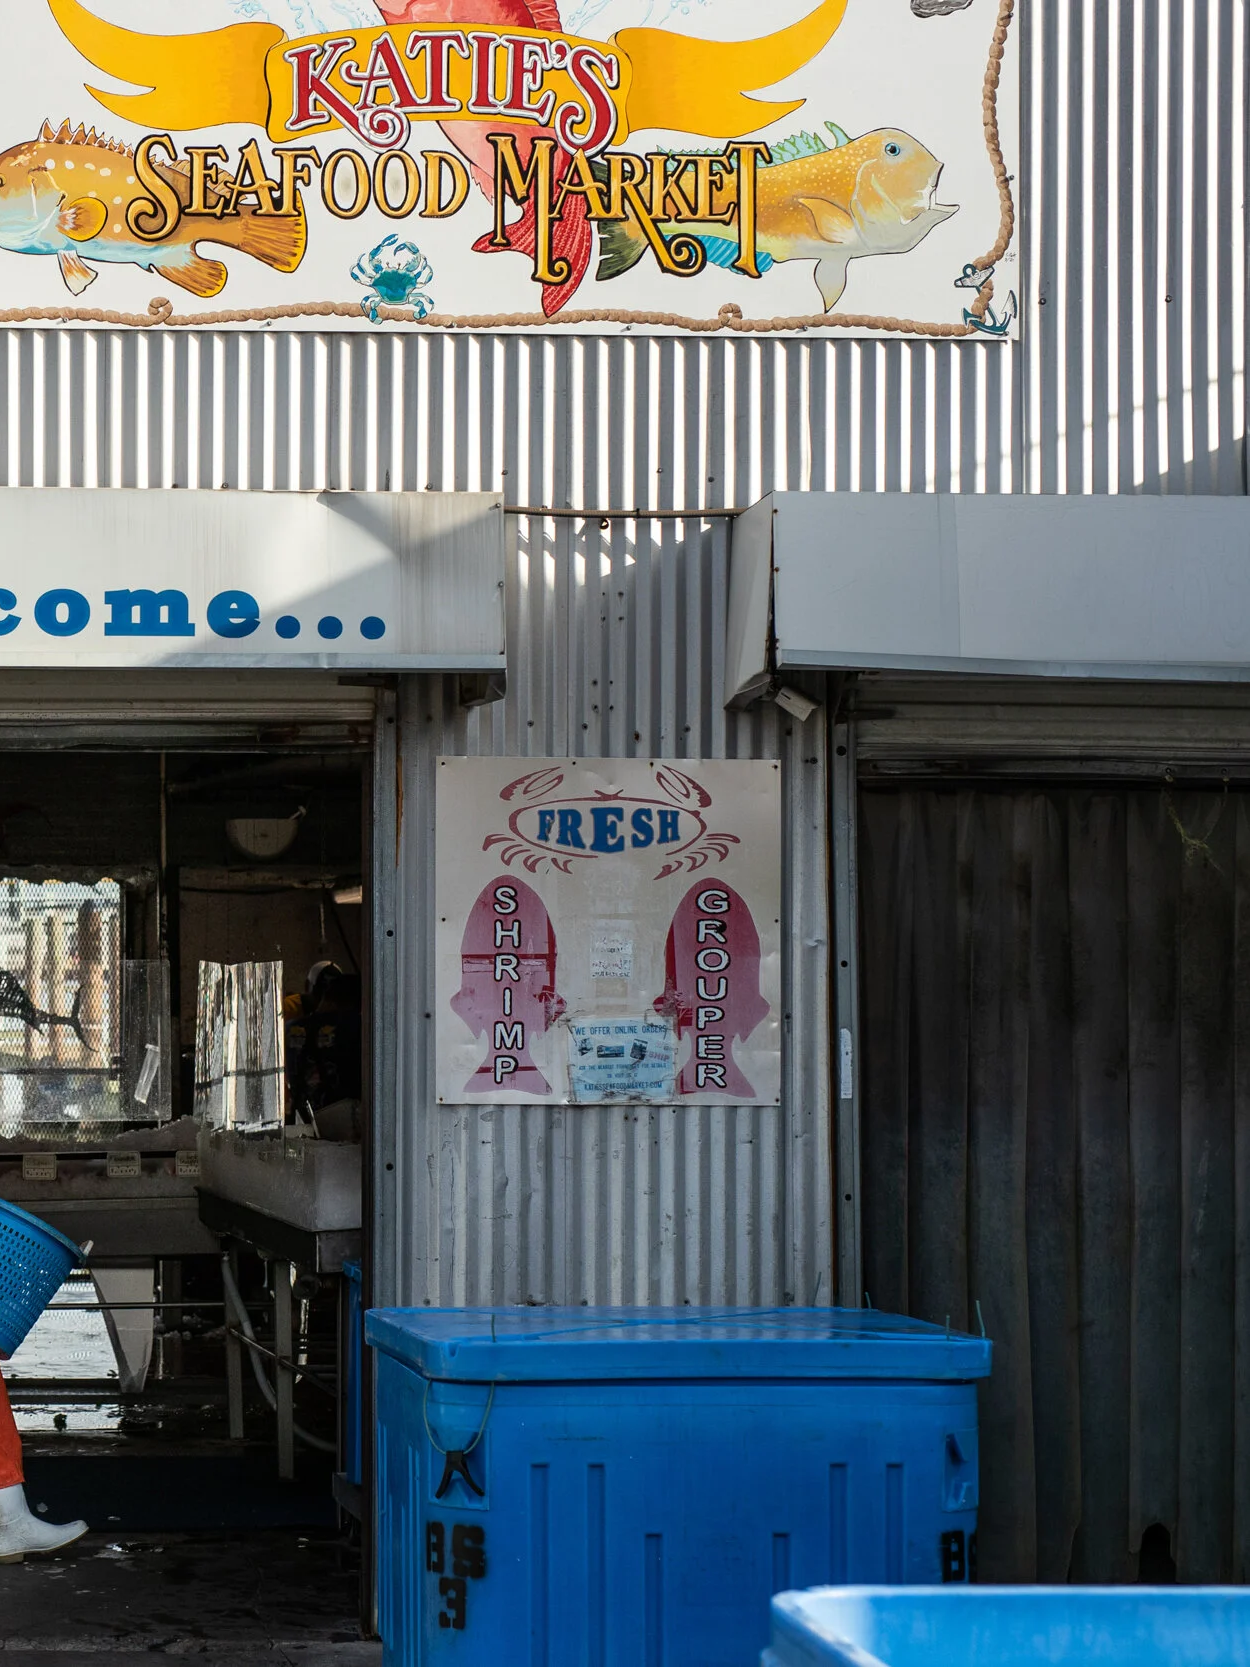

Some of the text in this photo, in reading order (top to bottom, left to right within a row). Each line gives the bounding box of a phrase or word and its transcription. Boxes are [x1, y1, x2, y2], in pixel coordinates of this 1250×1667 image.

[284, 29, 620, 154] KATIE'S
[126, 133, 777, 284] SEAFOOD MARKET
[537, 807, 680, 853] FRESH
[493, 885, 525, 1085] SHRIMP
[575, 1024, 667, 1036] WE OFFER ONLINE ORDERS
[696, 889, 730, 1089] GROUPER
